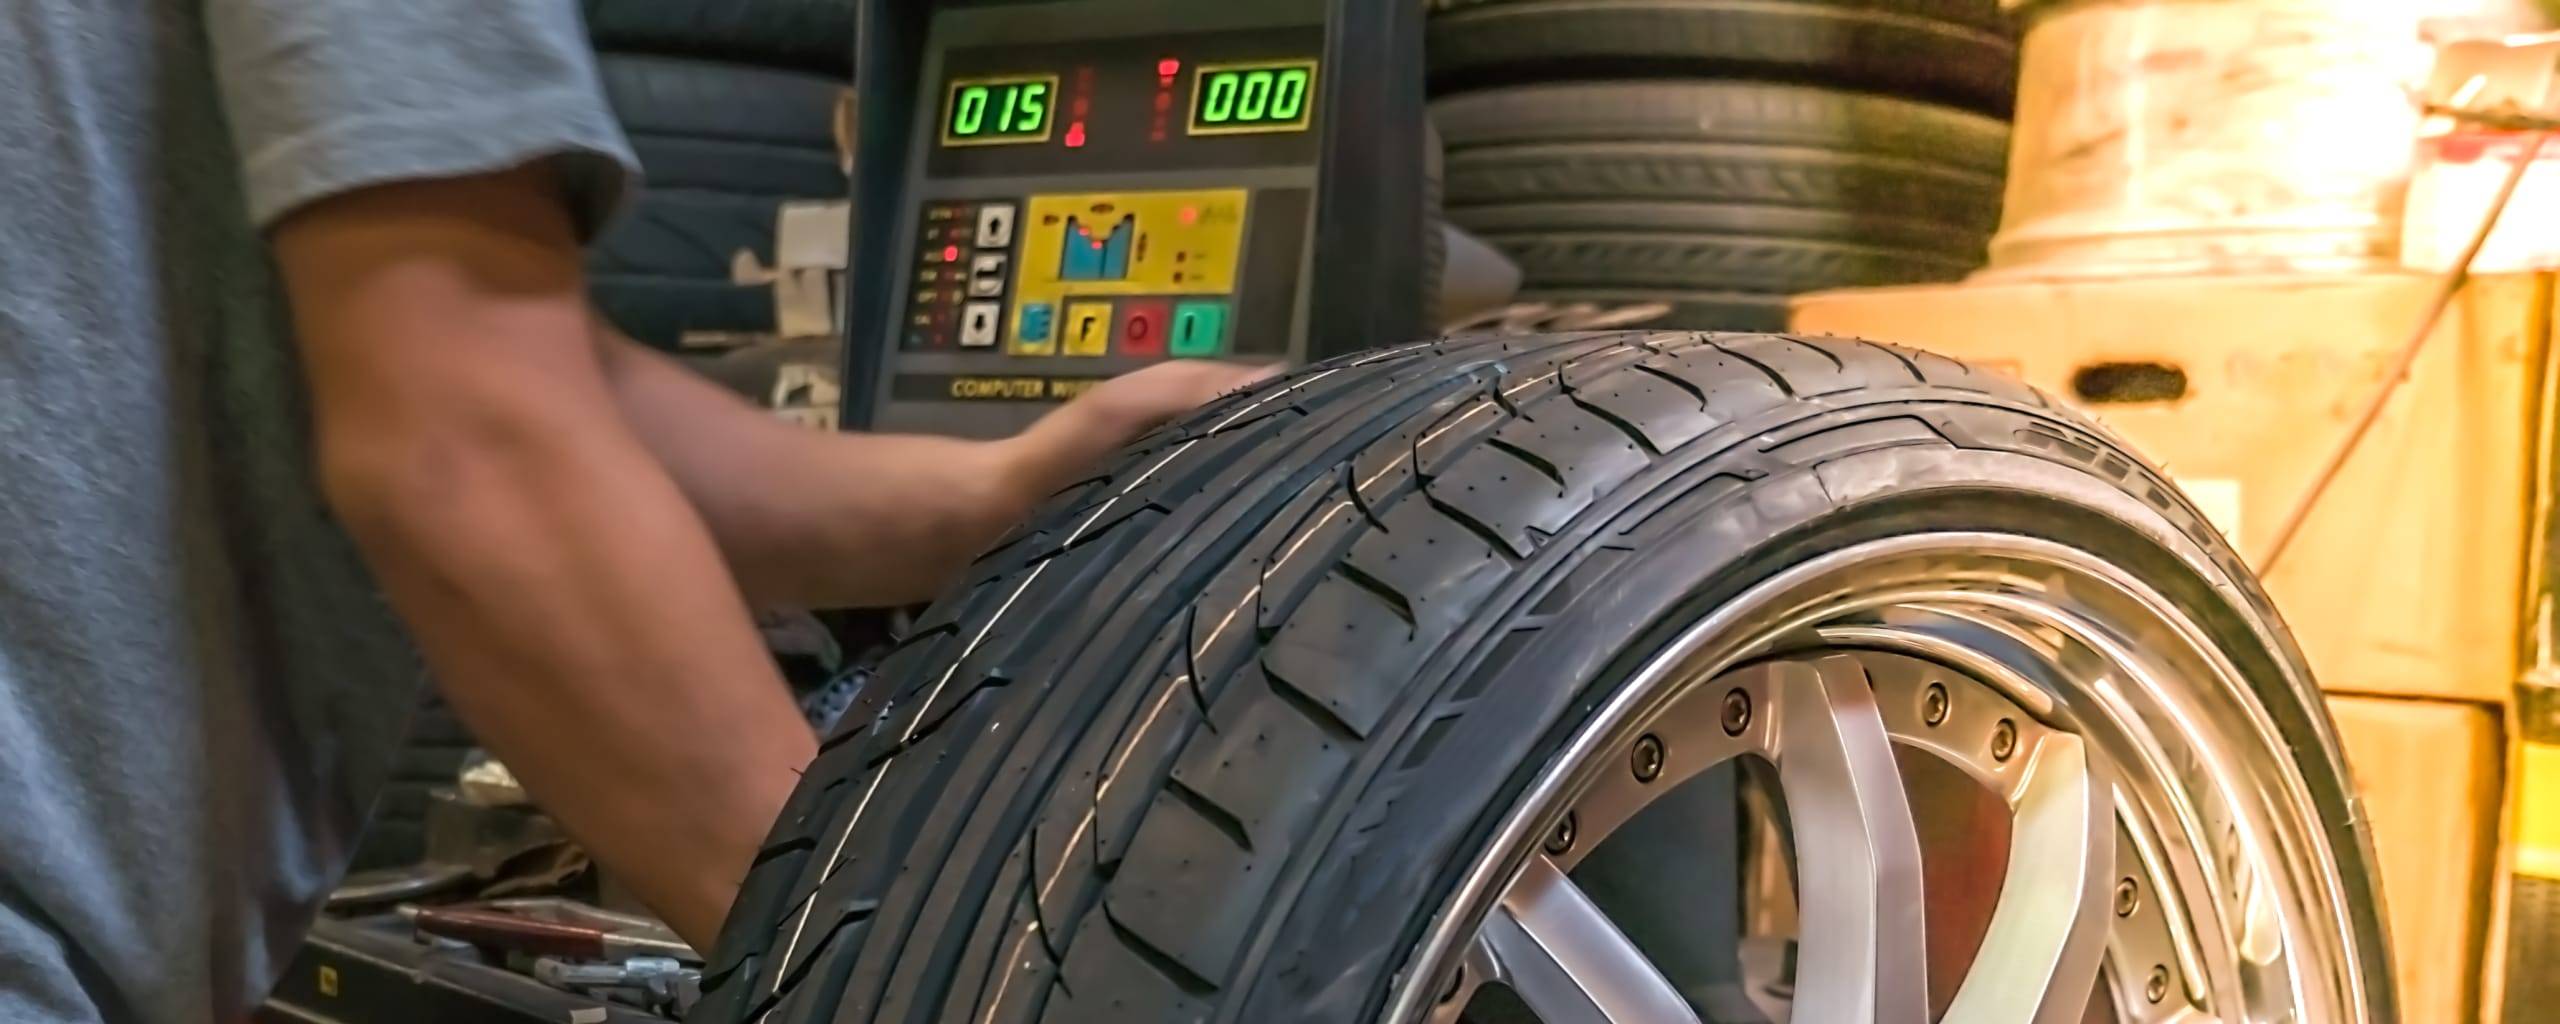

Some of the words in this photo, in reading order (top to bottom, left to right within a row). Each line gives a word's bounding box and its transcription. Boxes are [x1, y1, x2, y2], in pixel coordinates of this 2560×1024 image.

[954, 84, 1046, 134] 015
[1203, 70, 1307, 122] 000
[1080, 316, 1096, 343] F
[952, 379, 1044, 398] COMPUTER
